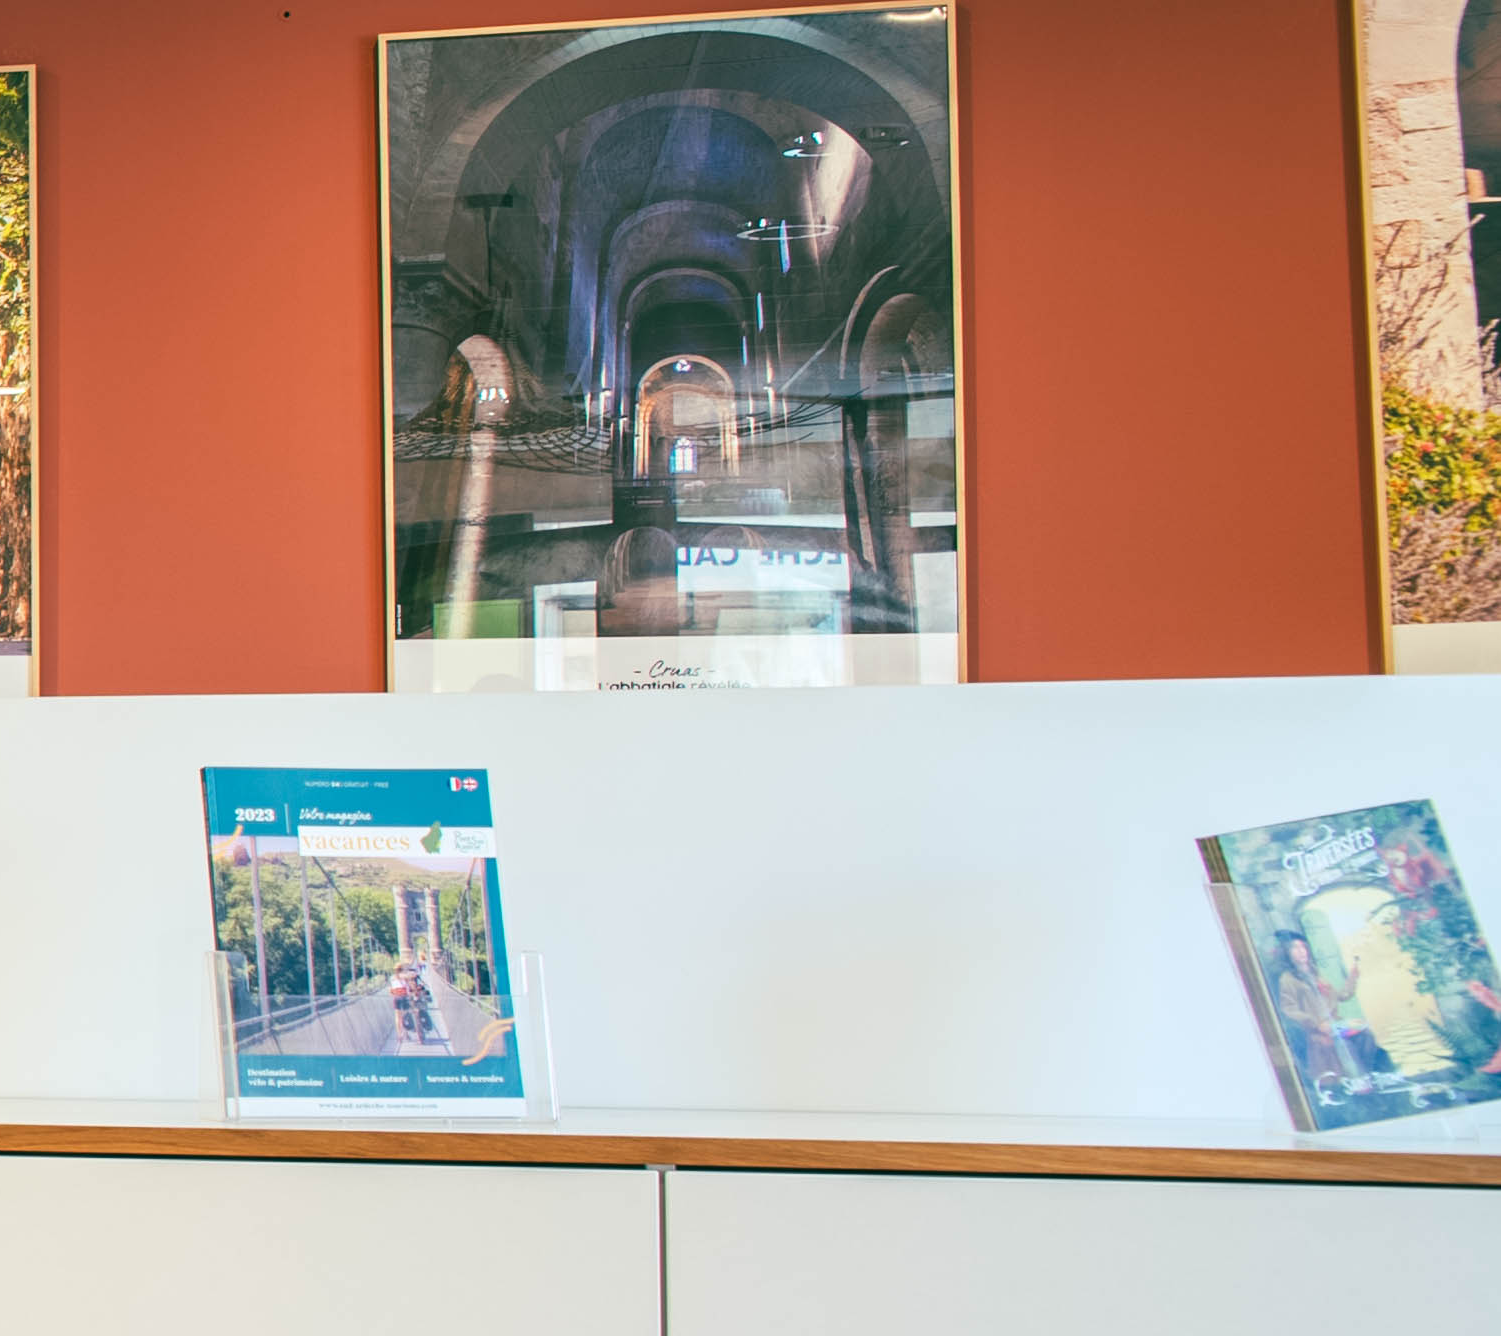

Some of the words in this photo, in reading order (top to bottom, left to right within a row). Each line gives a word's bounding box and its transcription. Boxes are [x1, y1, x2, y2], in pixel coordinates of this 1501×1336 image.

[648, 660, 703, 681] Cruas
[374, 781, 389, 789] FREE
[235, 807, 276, 822] 2023
[298, 807, 324, 821] Votre
[325, 810, 373, 824] magazine
[300, 833, 411, 851] vacances
[247, 1068, 297, 1078] Destination
[249, 1077, 266, 1088] vélo
[276, 1078, 325, 1090] patrimoine
[339, 1074, 370, 1084] Loisirs
[378, 1074, 409, 1084] nature
[426, 1074, 461, 1084] Saveurs
[470, 1075, 505, 1084] terroirs
